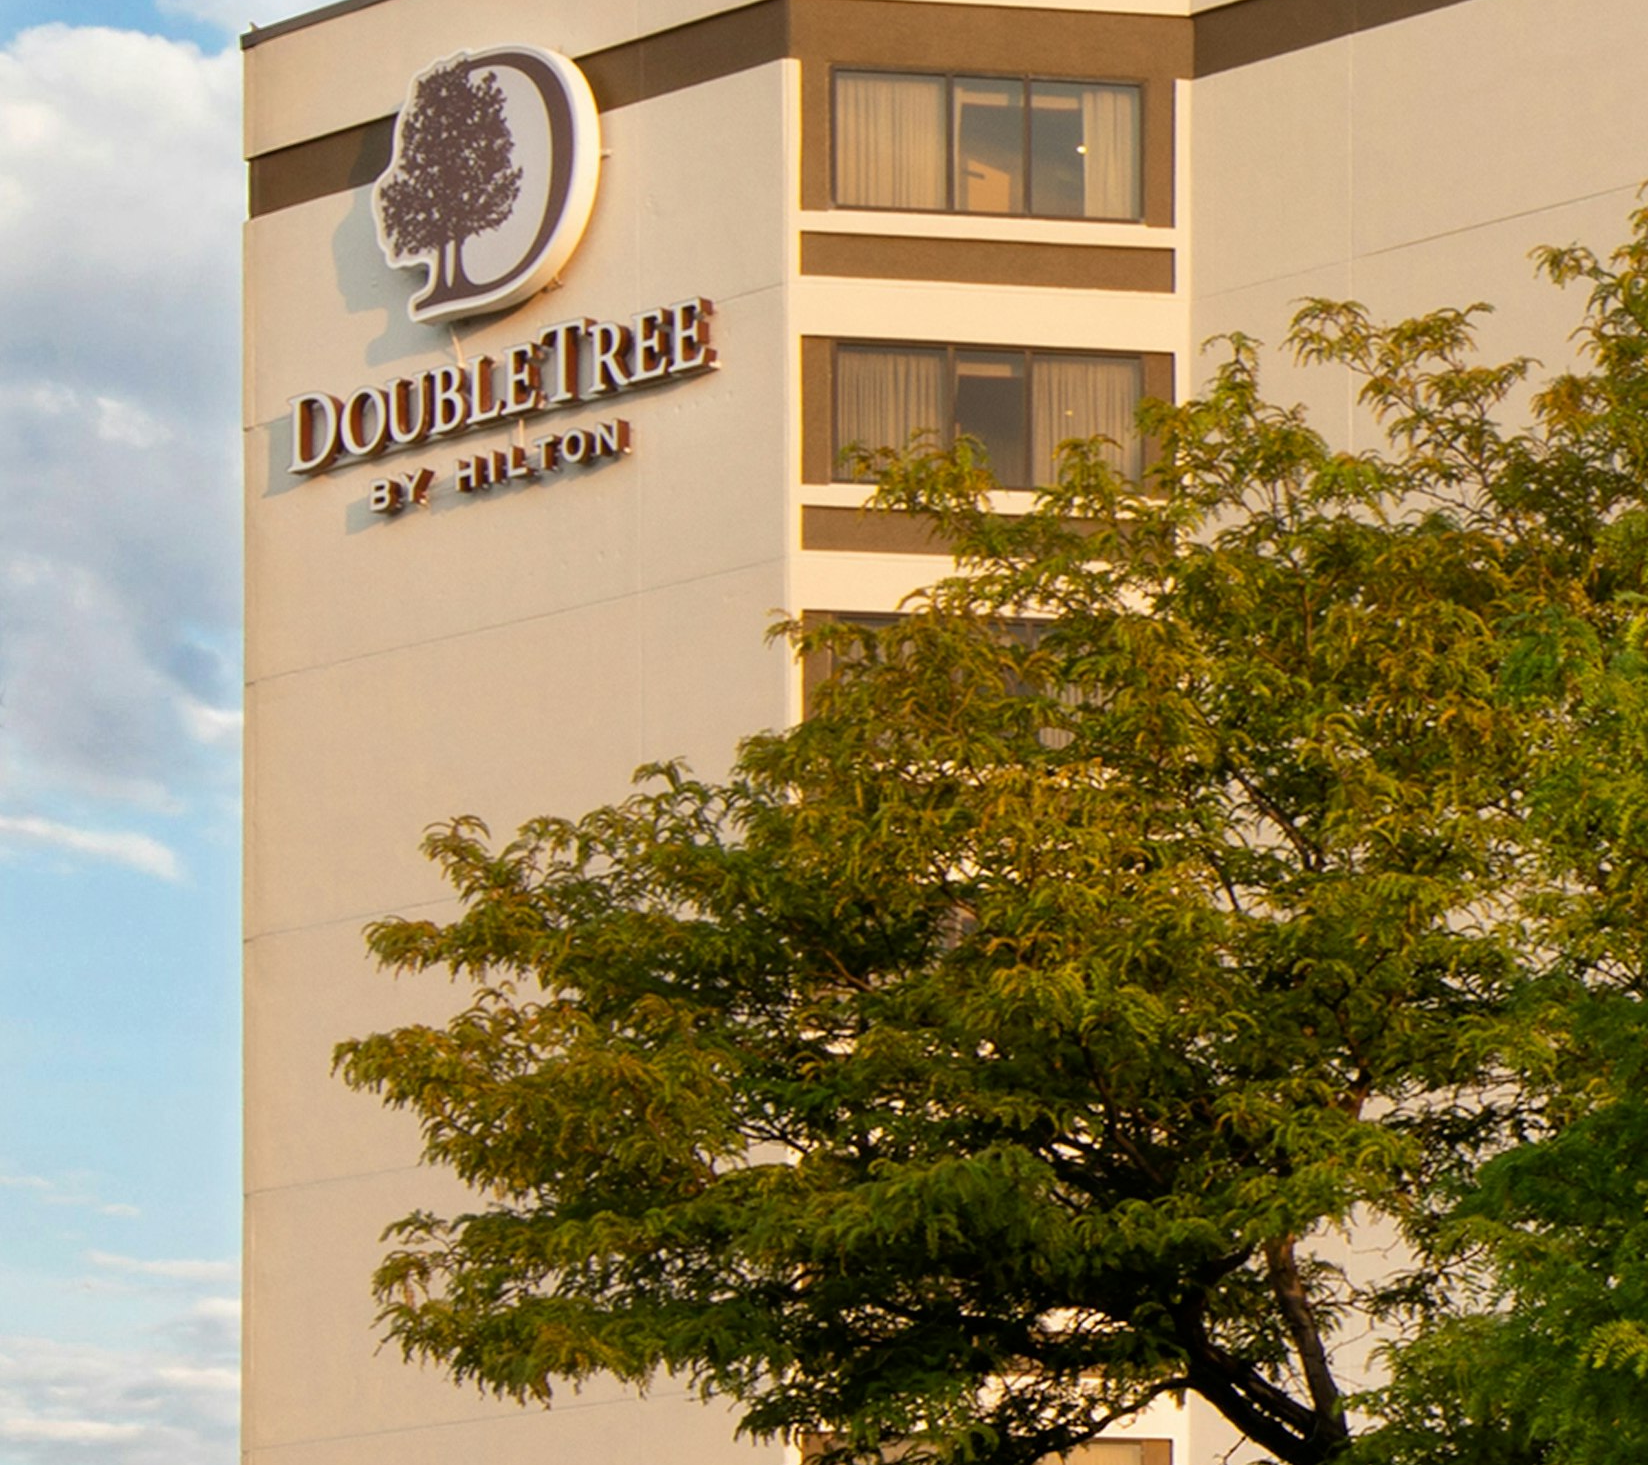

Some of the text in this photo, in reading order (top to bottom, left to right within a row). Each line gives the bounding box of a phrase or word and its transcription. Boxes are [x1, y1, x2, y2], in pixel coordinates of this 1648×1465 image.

[288, 296, 716, 474] DOUBLETREE
[370, 418, 631, 513] BY HILTON
